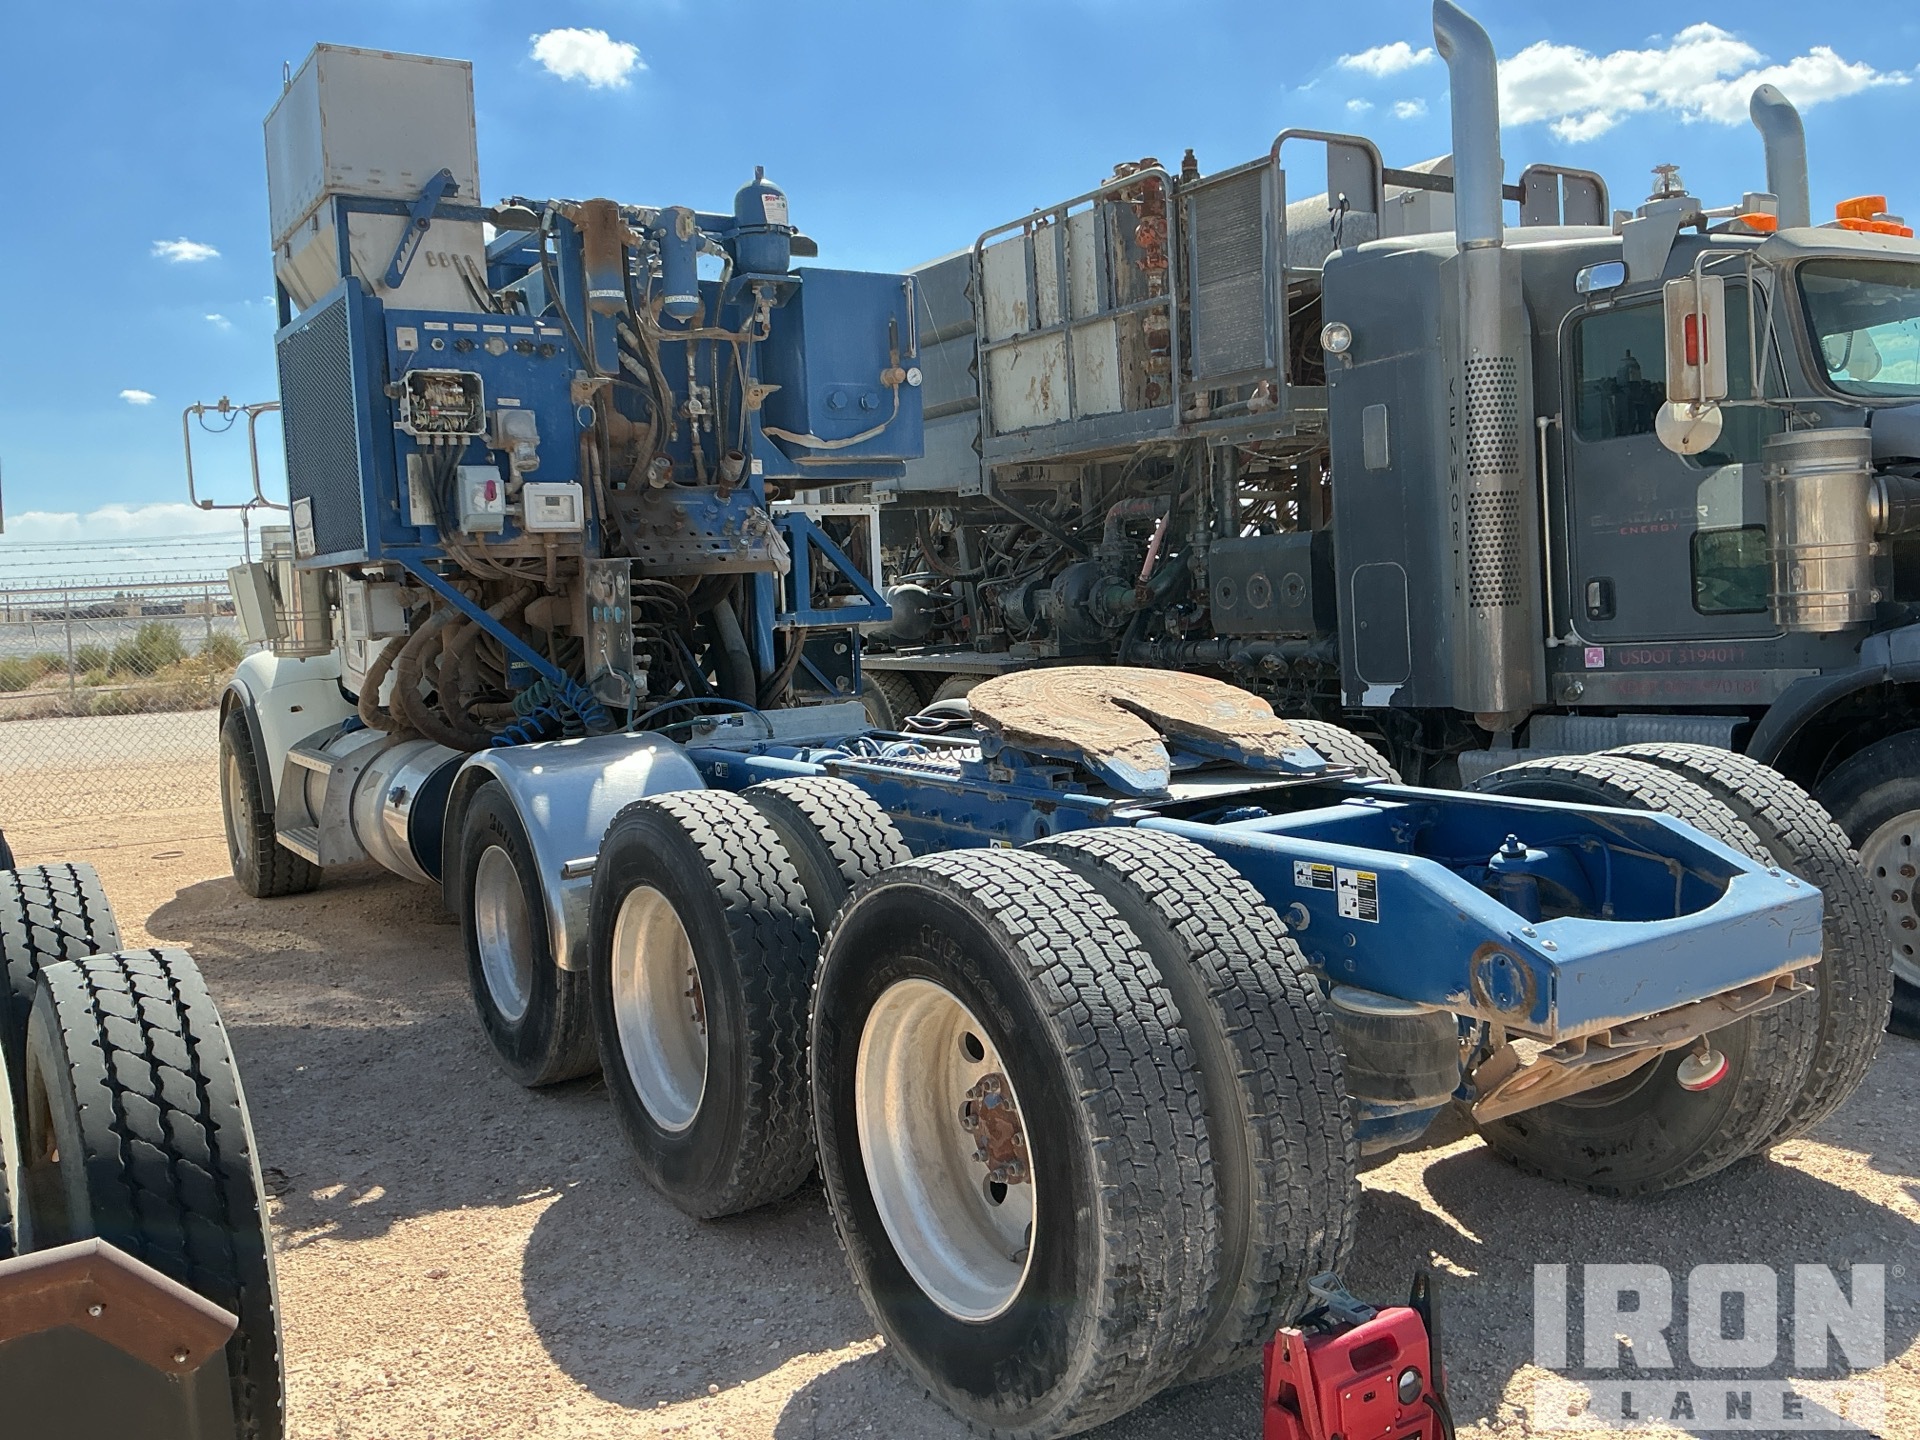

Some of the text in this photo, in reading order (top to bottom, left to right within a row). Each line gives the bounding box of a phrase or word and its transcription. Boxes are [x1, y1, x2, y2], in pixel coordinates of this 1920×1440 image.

[1449, 376, 1461, 599] KENWORTH
[1590, 504, 1709, 527] GLDIATOR
[1619, 523, 1680, 536] ENERGY
[1619, 648, 1745, 666] USDOT 3194011
